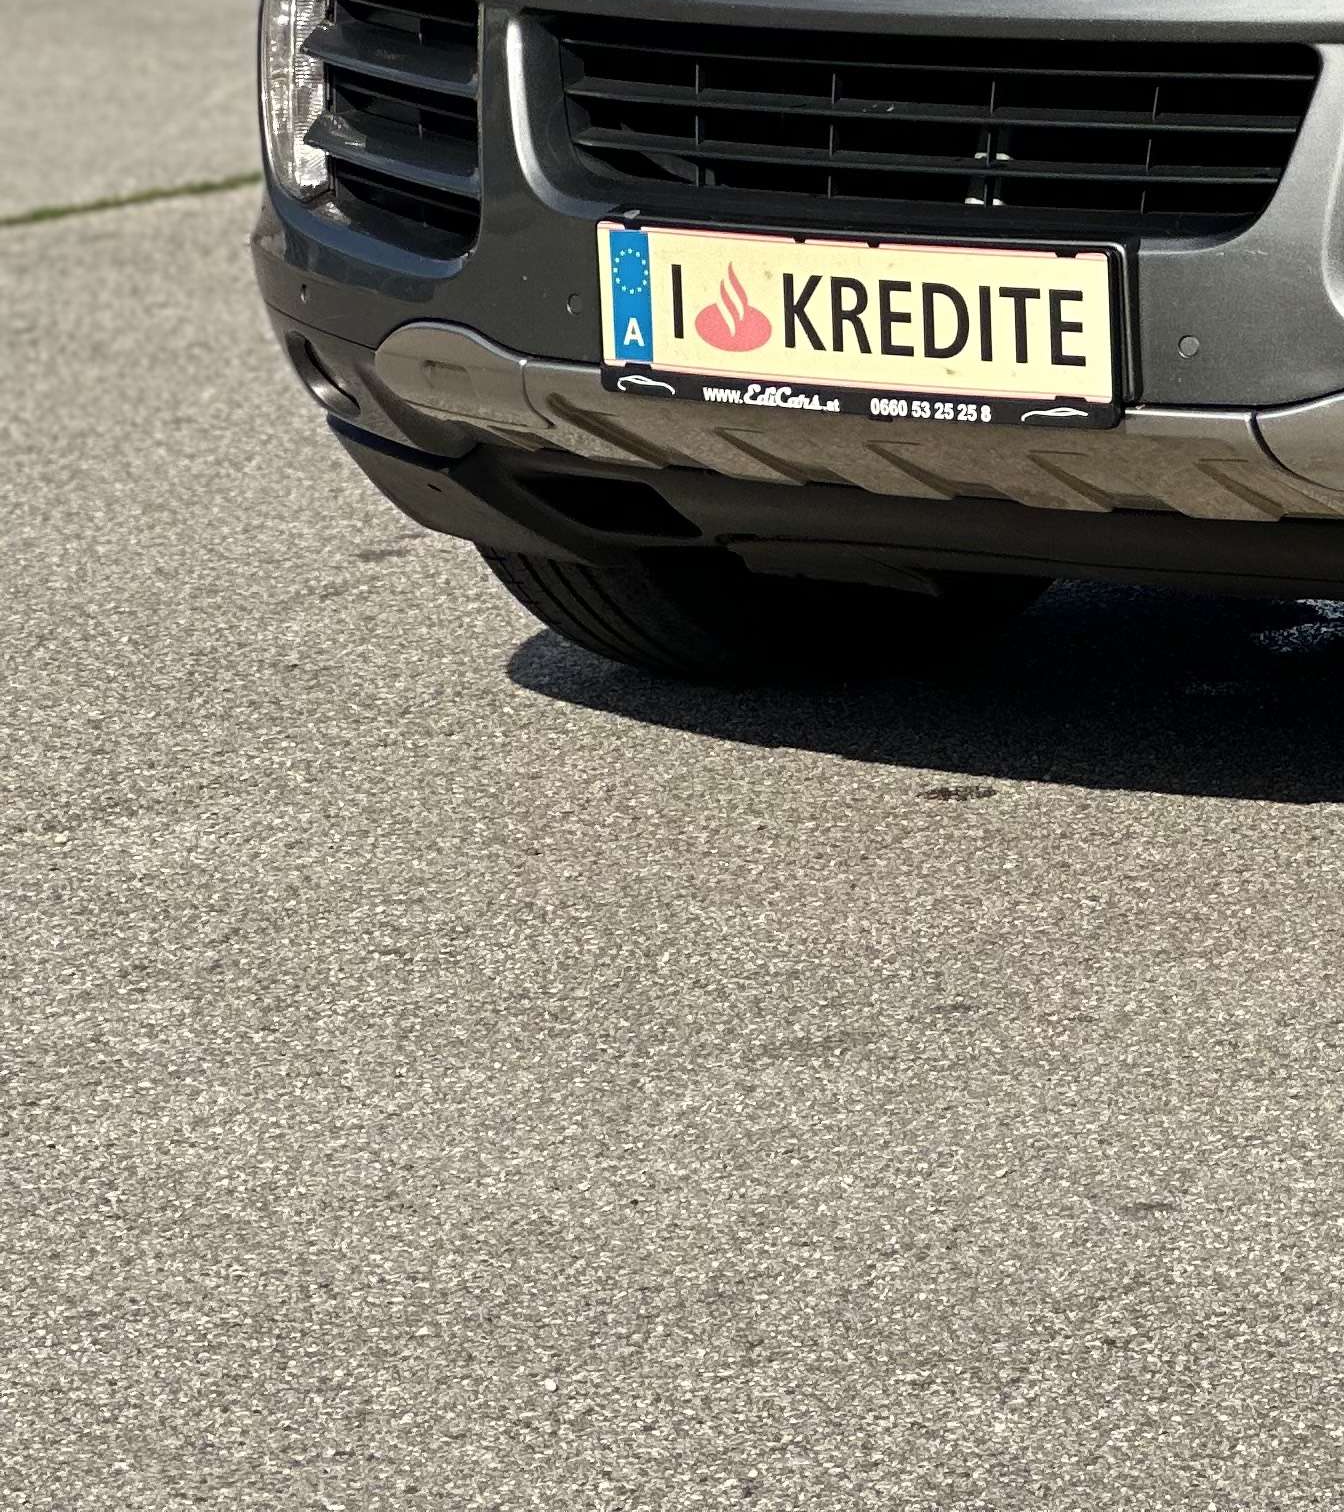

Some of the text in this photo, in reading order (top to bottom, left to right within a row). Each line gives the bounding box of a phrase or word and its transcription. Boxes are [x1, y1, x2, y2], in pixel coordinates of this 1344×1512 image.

[623, 316, 645, 347] A
[671, 263, 1087, 367] I KREDITE
[702, 384, 992, 423] www.EdiCars.at 0660 53 25 25 8
